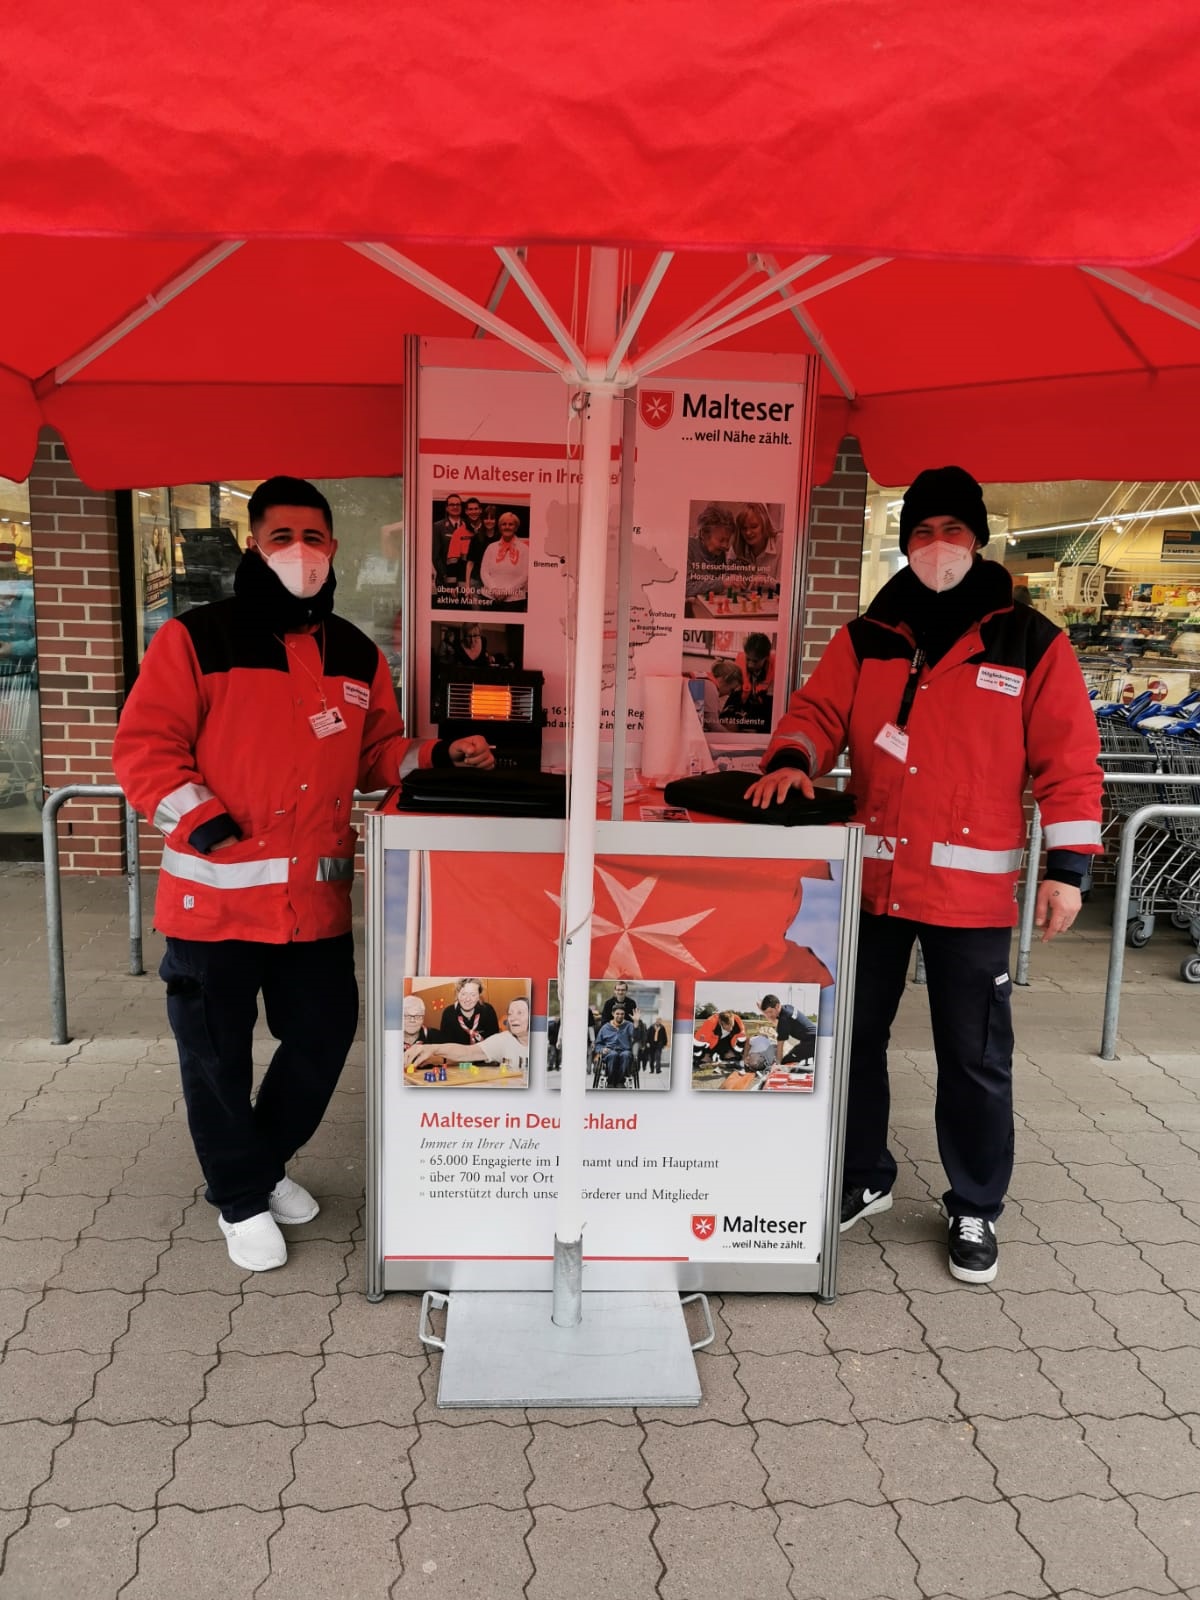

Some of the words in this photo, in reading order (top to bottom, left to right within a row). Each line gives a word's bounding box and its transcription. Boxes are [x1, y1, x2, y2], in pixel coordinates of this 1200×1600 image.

[682, 393, 795, 421] Malteser
[723, 430, 756, 443] Nähe
[758, 432, 792, 445] zählt.
[433, 464, 459, 479] Die
[463, 465, 535, 482] Malteser
[539, 468, 552, 484] in
[556, 468, 584, 484] Ihre
[691, 562, 700, 570] 15
[701, 562, 756, 572] Besuchsdienste
[437, 584, 454, 593] über
[456, 586, 475, 594] 1.000
[461, 597, 493, 606] Malteser
[649, 611, 676, 619] Wolfsburg
[551, 706, 562, 715] 16
[420, 1112, 501, 1128] Malteser
[505, 1113, 520, 1128] in
[526, 1112, 638, 1130] Deuhland
[420, 1138, 458, 1149] Immer
[461, 1139, 474, 1149] in
[477, 1138, 505, 1149] Ihrer
[509, 1138, 541, 1150] Nähe
[429, 1154, 468, 1166] 65.000
[472, 1154, 532, 1169] Engagierte
[536, 1156, 551, 1167] im
[616, 1156, 639, 1168] und
[643, 1156, 658, 1168] im
[662, 1156, 720, 1171] Hauptamt
[429, 1171, 455, 1183] über
[460, 1171, 480, 1183] 700
[484, 1171, 506, 1183] mal
[510, 1174, 529, 1183] vor
[532, 1171, 554, 1183] Ort
[429, 1187, 491, 1199] unterstützt
[495, 1187, 529, 1199] durch
[533, 1190, 559, 1199] unse
[581, 1188, 622, 1200] örderer
[625, 1188, 648, 1200] und
[651, 1188, 710, 1203] Mitglieder
[723, 1215, 807, 1233] Malteser
[753, 1240, 779, 1249] Nähe
[780, 1240, 806, 1250] zählt.
